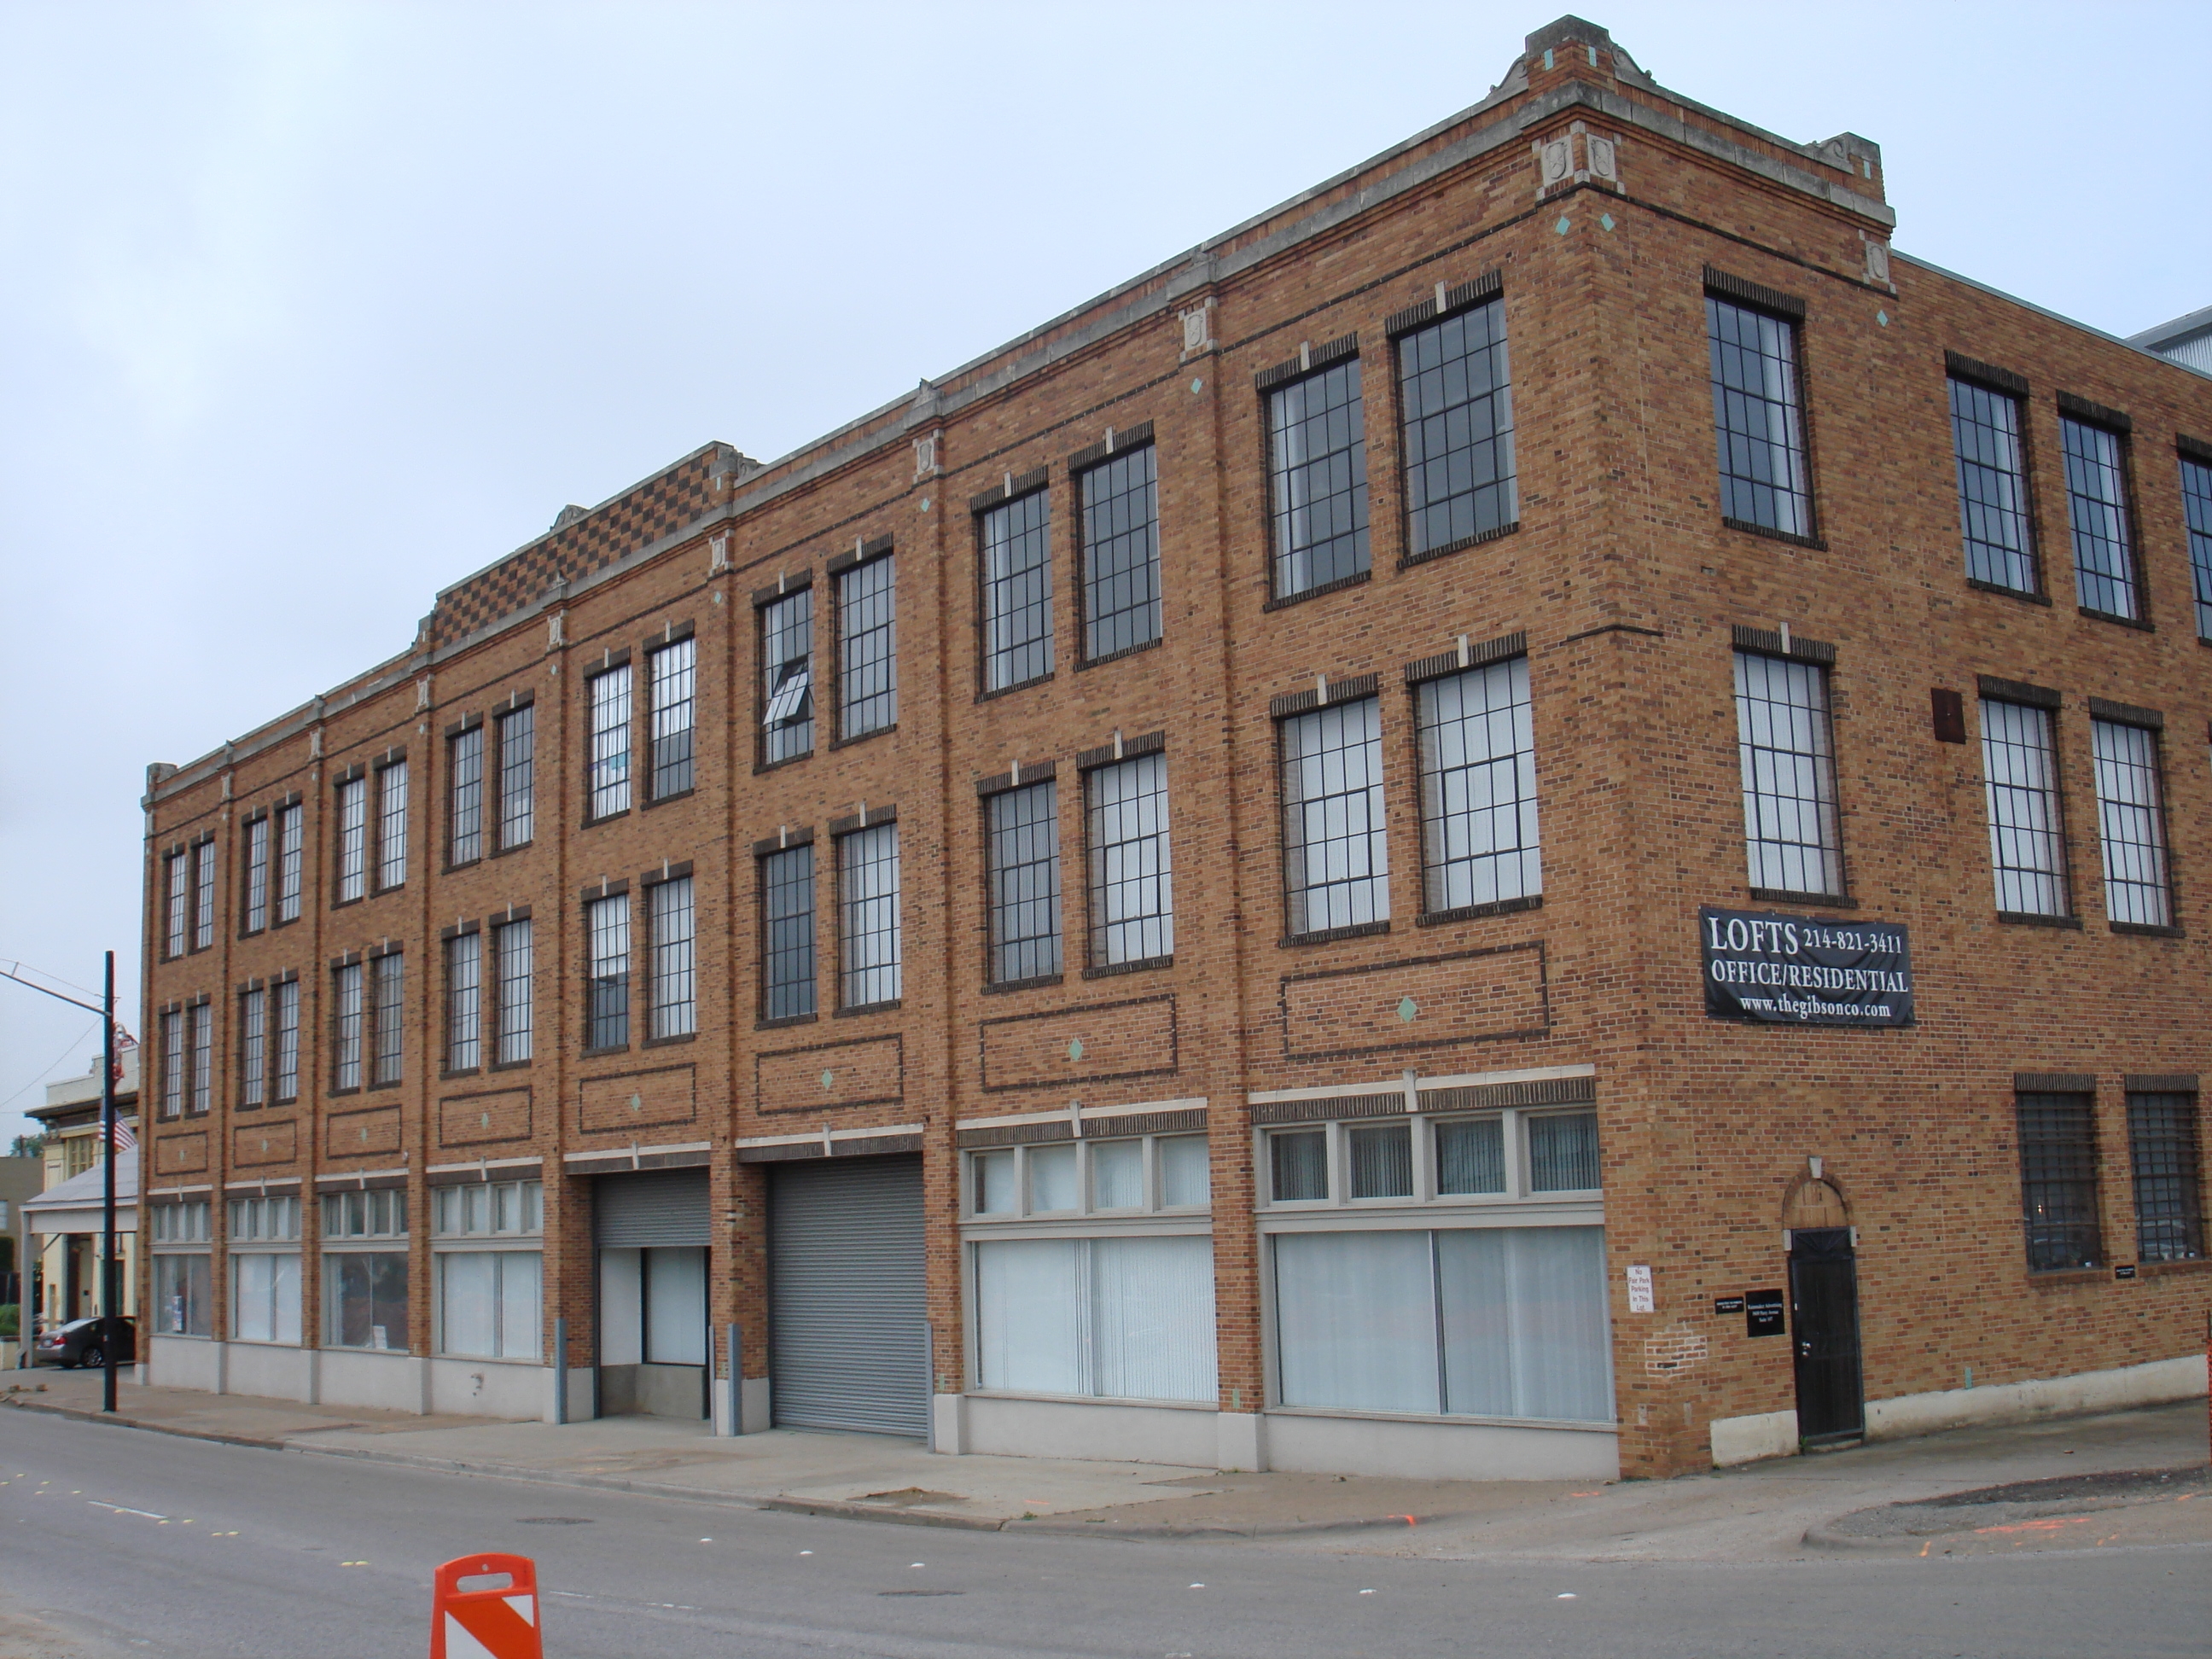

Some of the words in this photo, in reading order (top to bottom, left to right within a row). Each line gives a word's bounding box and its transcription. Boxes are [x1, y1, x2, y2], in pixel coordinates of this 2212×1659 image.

[1708, 917, 1799, 955] LOFTS
[1803, 928, 1902, 954] 214-821-3411
[1711, 959, 1909, 992] OFFICE/RESIDENTIAL
[1739, 993, 1891, 1019] www.thegibsonco.com
